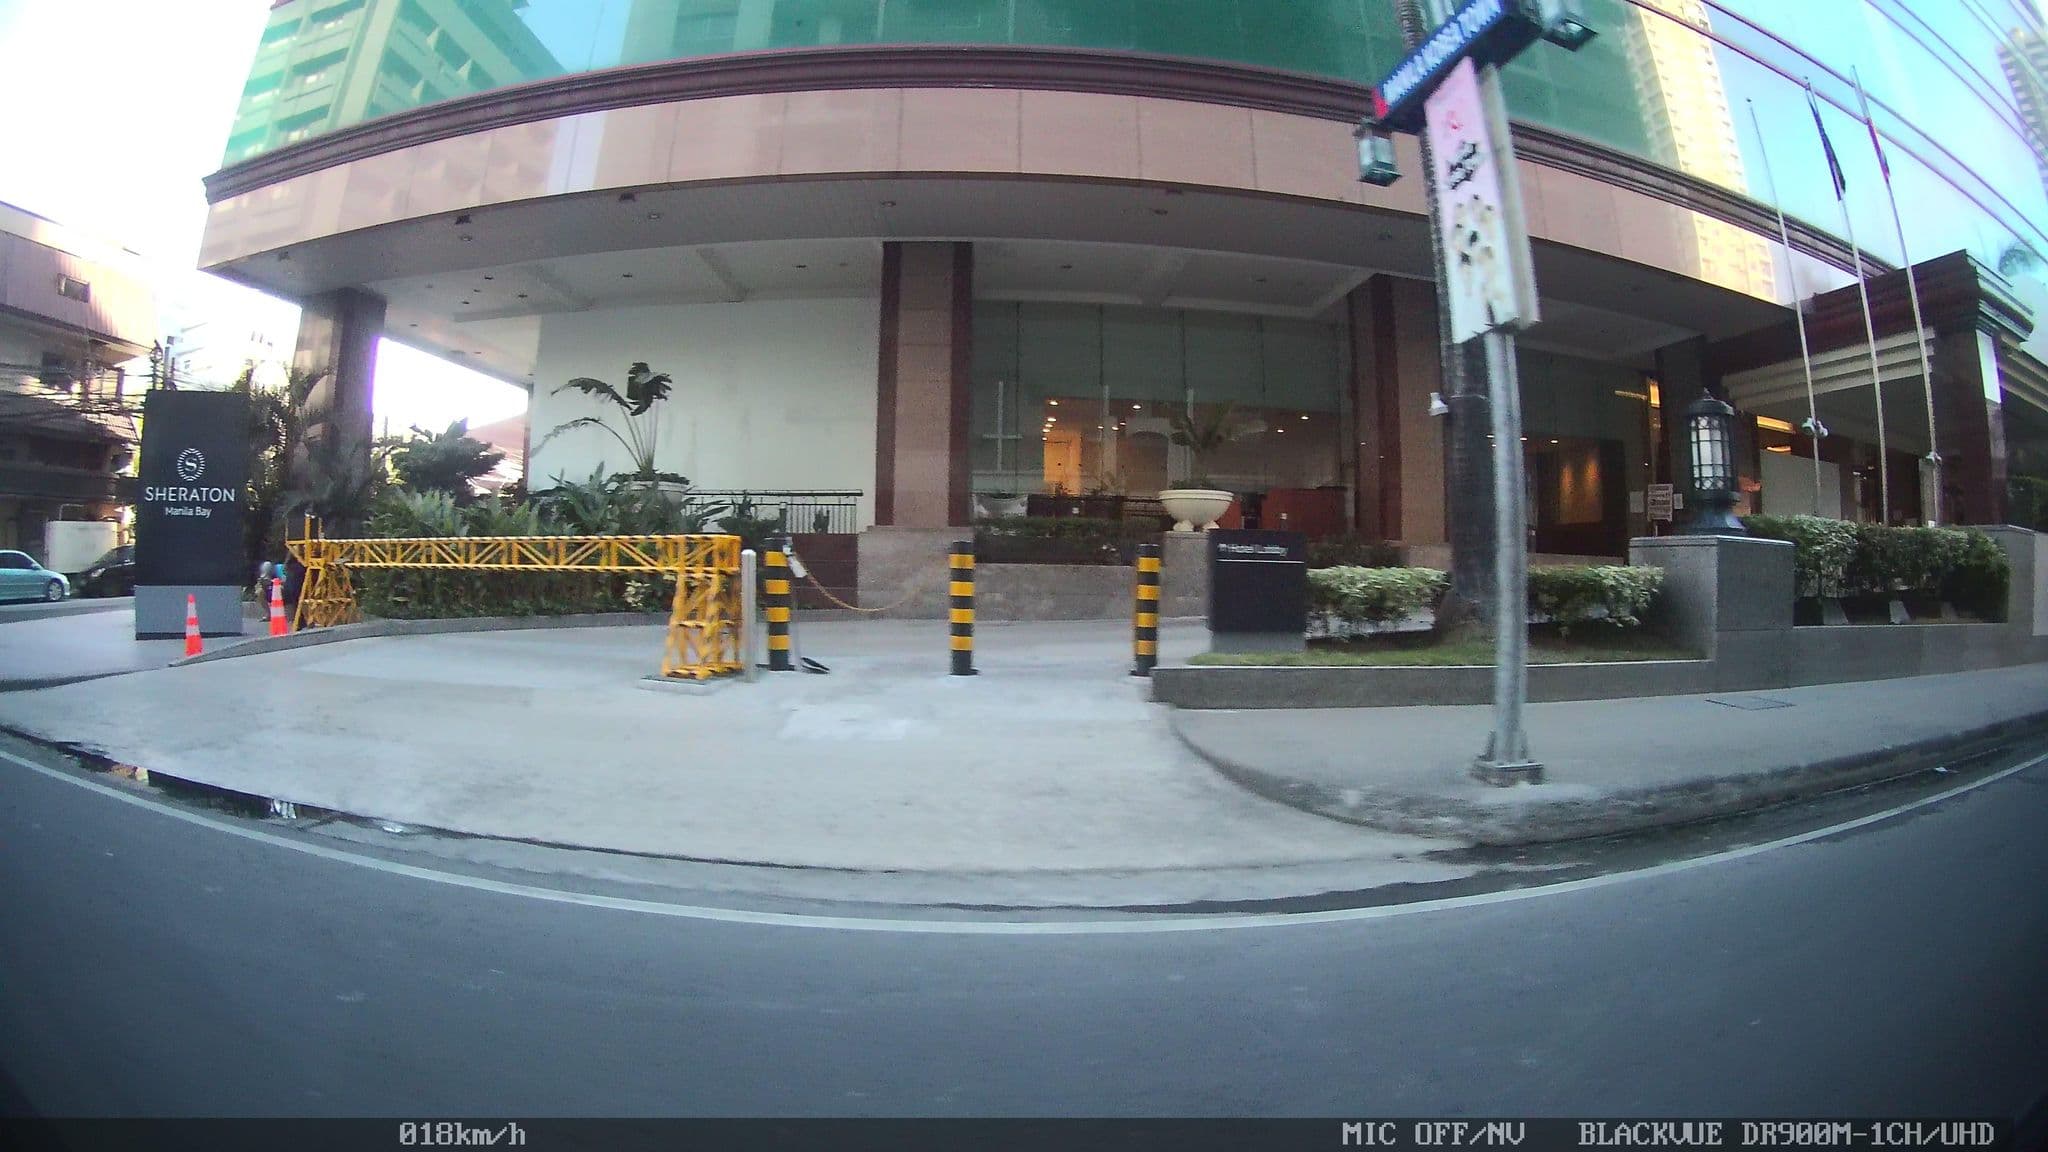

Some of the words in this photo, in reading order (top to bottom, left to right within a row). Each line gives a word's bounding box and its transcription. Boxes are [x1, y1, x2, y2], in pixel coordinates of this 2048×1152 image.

[145, 486, 236, 502] SHERATON
[165, 506, 194, 516] Manila
[195, 506, 212, 519] Bay
